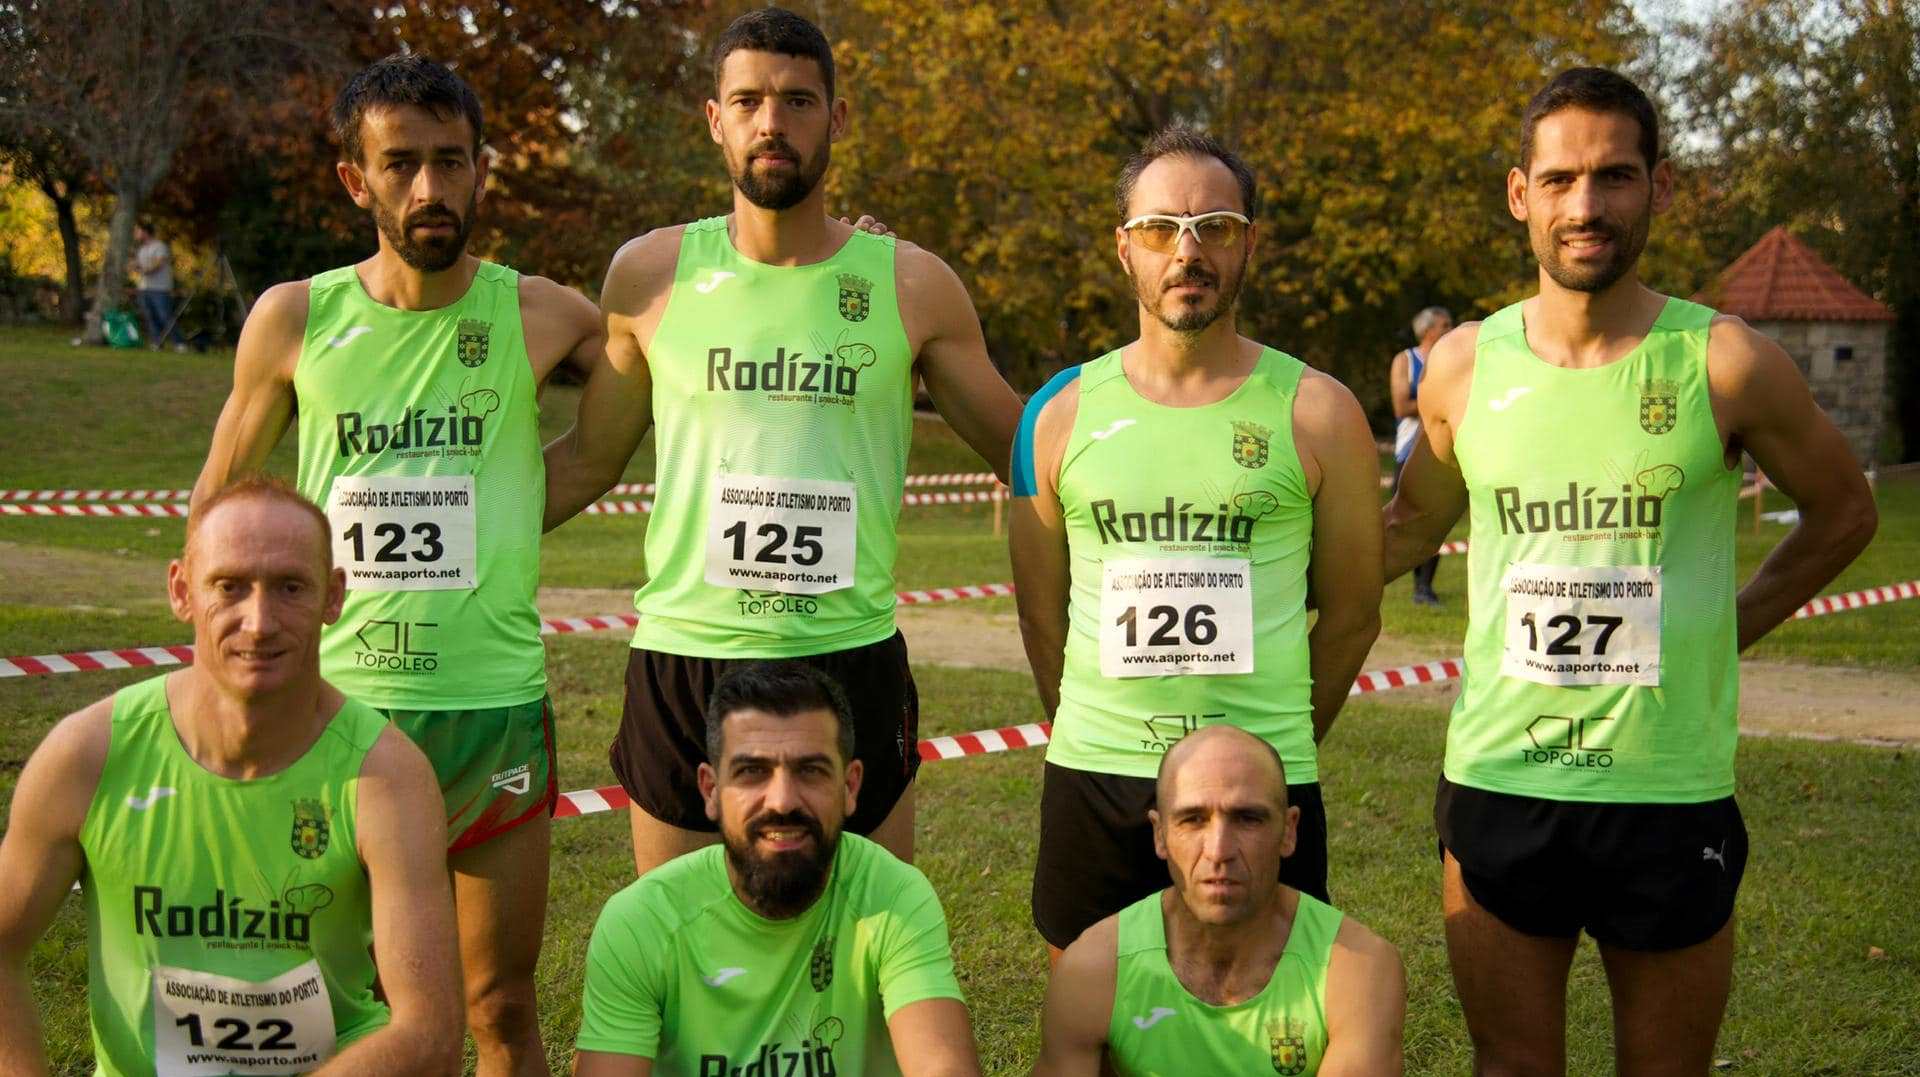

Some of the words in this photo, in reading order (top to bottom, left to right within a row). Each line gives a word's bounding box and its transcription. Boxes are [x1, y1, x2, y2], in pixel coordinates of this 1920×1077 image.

[707, 347, 856, 396] Rodízio
[336, 405, 483, 458] Rodízio
[338, 488, 377, 511] SSOCIAÇÃO
[379, 491, 389, 507] DE
[390, 490, 431, 507] ATLETISMO
[433, 491, 443, 506] DO
[445, 490, 469, 506] PORTO
[765, 491, 775, 507] DE
[776, 492, 815, 510] ATLETISMO
[817, 495, 827, 510] DO
[828, 496, 851, 512] PORTO
[1494, 482, 1662, 535] Rodízio
[1091, 497, 1253, 545] Rodízio
[343, 522, 445, 563] 123
[723, 520, 823, 566] 125
[352, 567, 461, 580] www.aaporto.net
[728, 567, 838, 583] www.aaporto.net
[1153, 573, 1163, 589] DE
[1164, 572, 1204, 589] ATLETISMO
[1207, 572, 1217, 588] DO
[1219, 573, 1243, 588] PORTO
[1556, 582, 1566, 597] DE
[1568, 582, 1611, 598] ATLETISMO
[1614, 582, 1624, 597] DO
[1626, 581, 1653, 598] PORTO
[738, 598, 817, 615] TOPOLEO
[1116, 604, 1218, 647] 126
[1521, 612, 1622, 656] 127
[355, 651, 437, 671] TOPOLEO
[1122, 652, 1235, 665] www.aaporto.net
[1525, 657, 1639, 674] www.aaporto.net
[1521, 750, 1613, 768] TOPOLEO
[134, 885, 310, 942] Rodízio
[166, 981, 215, 1005] ASSOCIAÇÃO
[218, 992, 229, 1005] DE
[231, 992, 277, 1007] ATLETISMO
[280, 990, 291, 1004] DO
[294, 977, 319, 1003] PORTO
[176, 1013, 297, 1050] 122
[187, 1053, 318, 1067] www.aaporto.net
